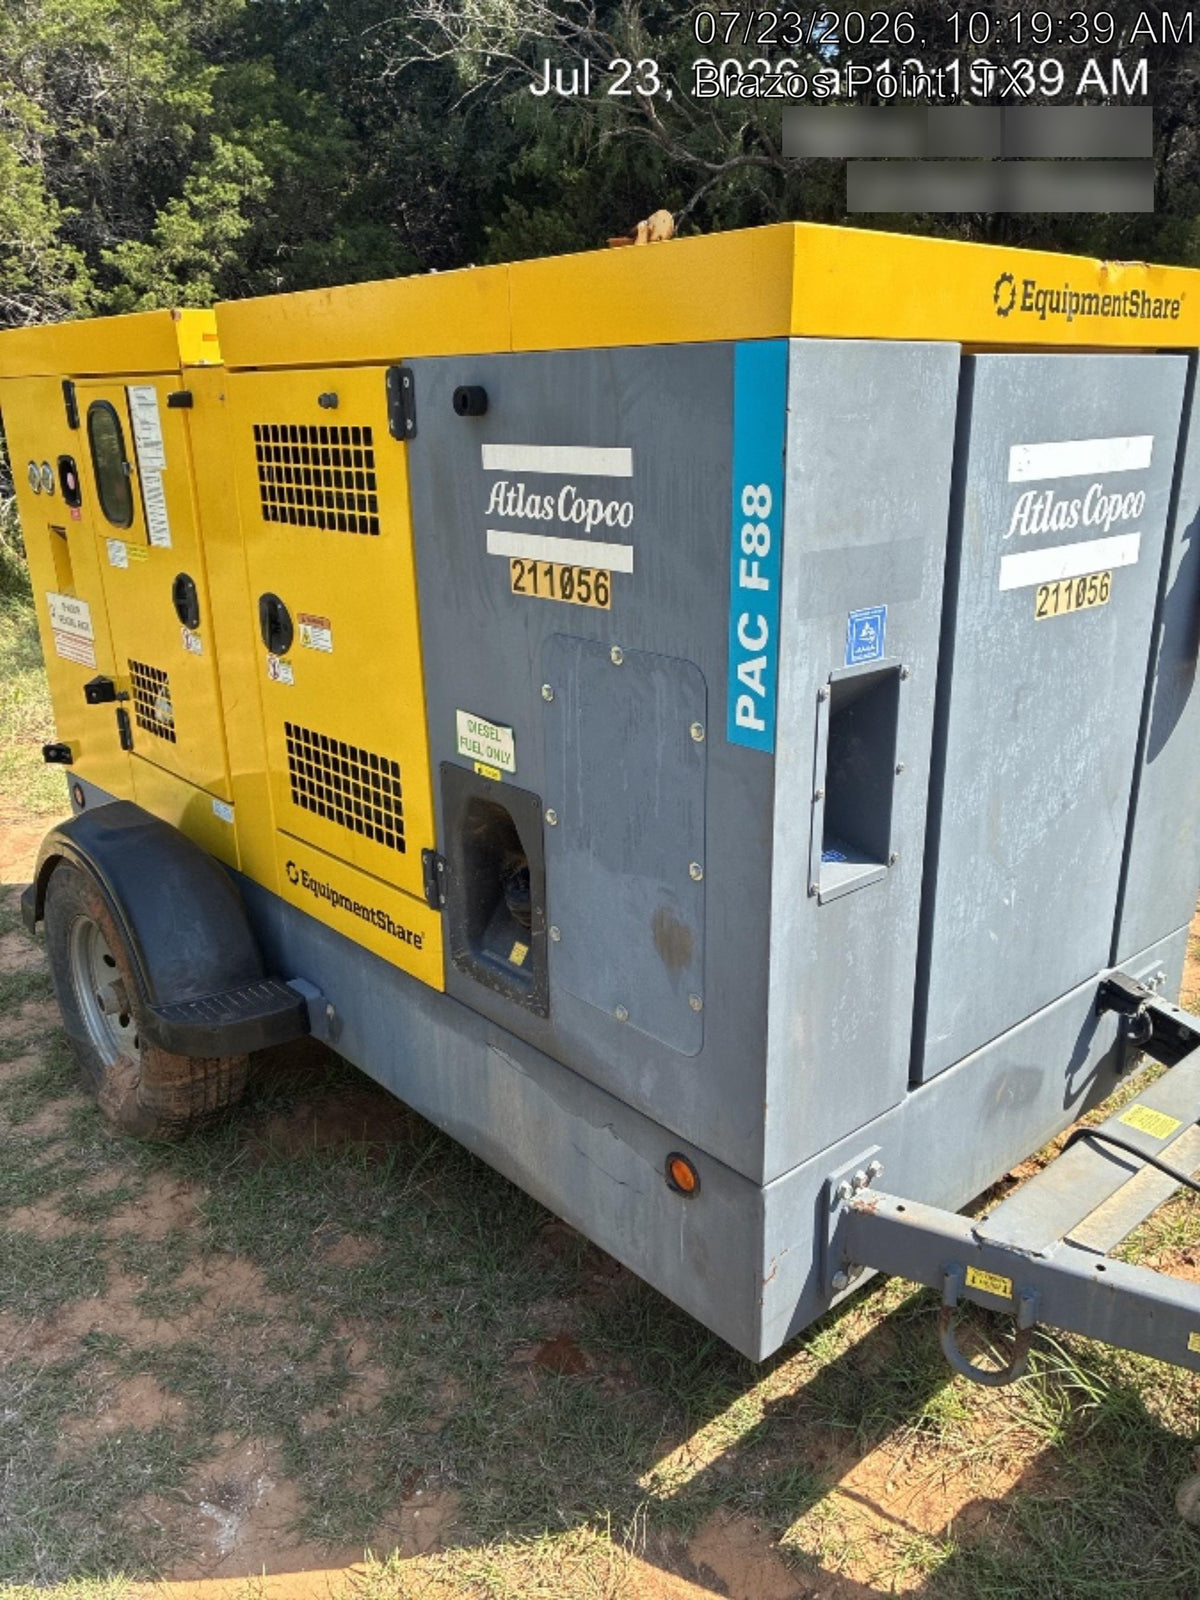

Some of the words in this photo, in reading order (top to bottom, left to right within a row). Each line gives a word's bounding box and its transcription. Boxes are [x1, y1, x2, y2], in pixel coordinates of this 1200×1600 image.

[1020, 280, 1181, 322] EquipmentShare
[485, 481, 555, 520] Atlas
[557, 484, 634, 533] Copco
[1003, 490, 1082, 540] Atlas
[1082, 482, 1146, 532] Copco
[739, 482, 773, 592] F88
[511, 558, 610, 607] 211056
[1036, 571, 1111, 618] 211056
[735, 612, 769, 732] PAC
[460, 735, 484, 757] FUEL
[486, 745, 511, 765] ONLY
[467, 719, 502, 743] DIESEL
[300, 869, 424, 950] EquipmentShare
